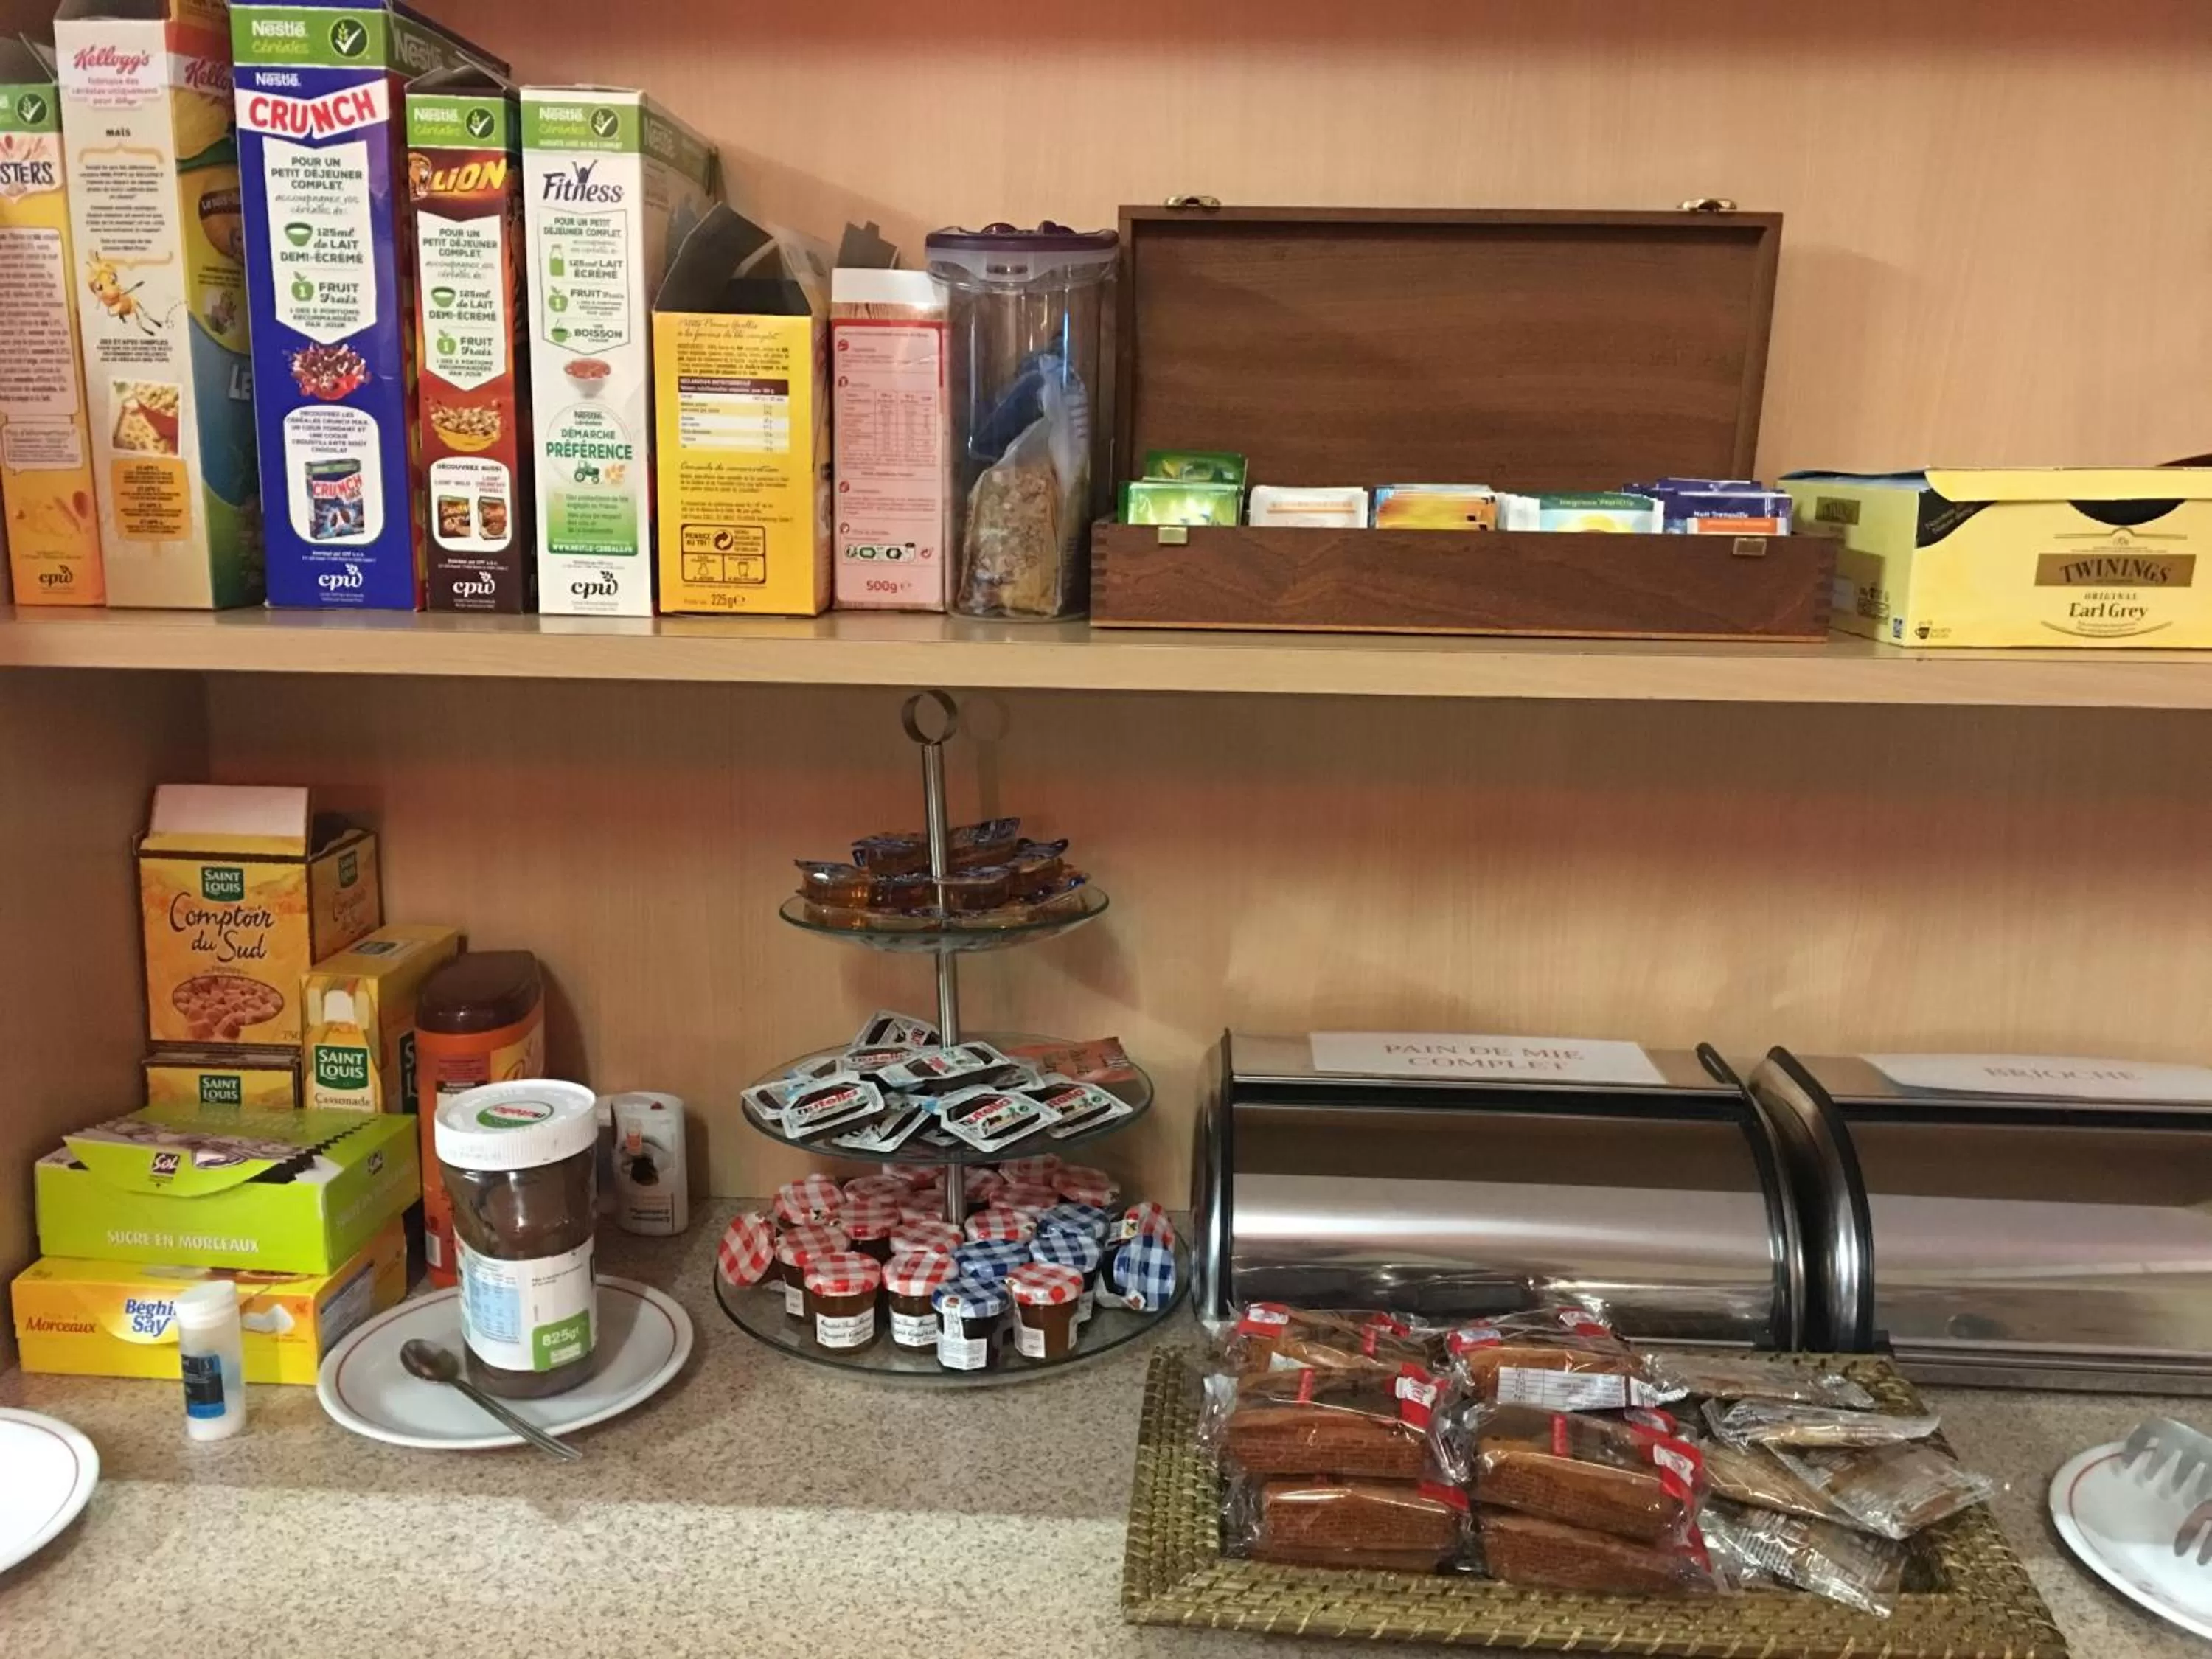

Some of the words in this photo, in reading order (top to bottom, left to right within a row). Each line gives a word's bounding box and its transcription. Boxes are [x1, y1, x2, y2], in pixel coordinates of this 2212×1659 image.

[251, 20, 307, 37] Nestlé
[73, 45, 150, 74] Kellogg's
[255, 72, 301, 86] Nestlé
[249, 89, 377, 133] CRUNCH
[291, 157, 321, 167] POUR
[325, 158, 341, 167] UN
[271, 169, 299, 178] PETIT
[433, 158, 507, 192] LION
[543, 170, 623, 203] Fitness
[554, 217, 574, 225] POUR
[439, 229, 463, 237] POUR
[330, 240, 359, 249] LAIT
[422, 237, 446, 247] PETIT
[599, 260, 624, 268] LAIT
[319, 282, 359, 293] FRUIT
[570, 288, 602, 298] FRUIT
[470, 300, 493, 309] LAIT
[574, 328, 622, 338] BOISSON
[460, 337, 493, 346] FRUIT
[560, 427, 616, 440] DÉMARCHE
[546, 440, 633, 461] PRÉFÉRENCE
[313, 473, 363, 497] CRUNCH
[2058, 557, 2171, 584] TWININGS
[866, 580, 897, 593] 500g
[2069, 602, 2105, 618] Earl
[2108, 602, 2149, 621] Grey
[204, 870, 240, 881] SAINT
[205, 883, 241, 894] LOUIS
[169, 892, 275, 936] Comptoir
[192, 931, 218, 952] du
[217, 931, 267, 962] Sud
[319, 1050, 364, 1065] SAINT
[1385, 1044, 1456, 1055] PAIN
[1469, 1045, 1512, 1057] DE
[1523, 1047, 1584, 1060] MIE
[1408, 1057, 1570, 1071] COMPLET
[320, 1065, 364, 1080] LOUIS
[202, 1079, 237, 1089] SAINT
[203, 1090, 238, 1102] LOUIS
[315, 1093, 371, 1107] Cassonade
[108, 1230, 150, 1245] SUCRE
[154, 1233, 173, 1247] EN
[180, 1235, 260, 1253] MORCEAUX
[26, 1316, 97, 1334] Morceaux
[132, 1315, 171, 1337] Say
[543, 1329, 577, 1346] 825g
